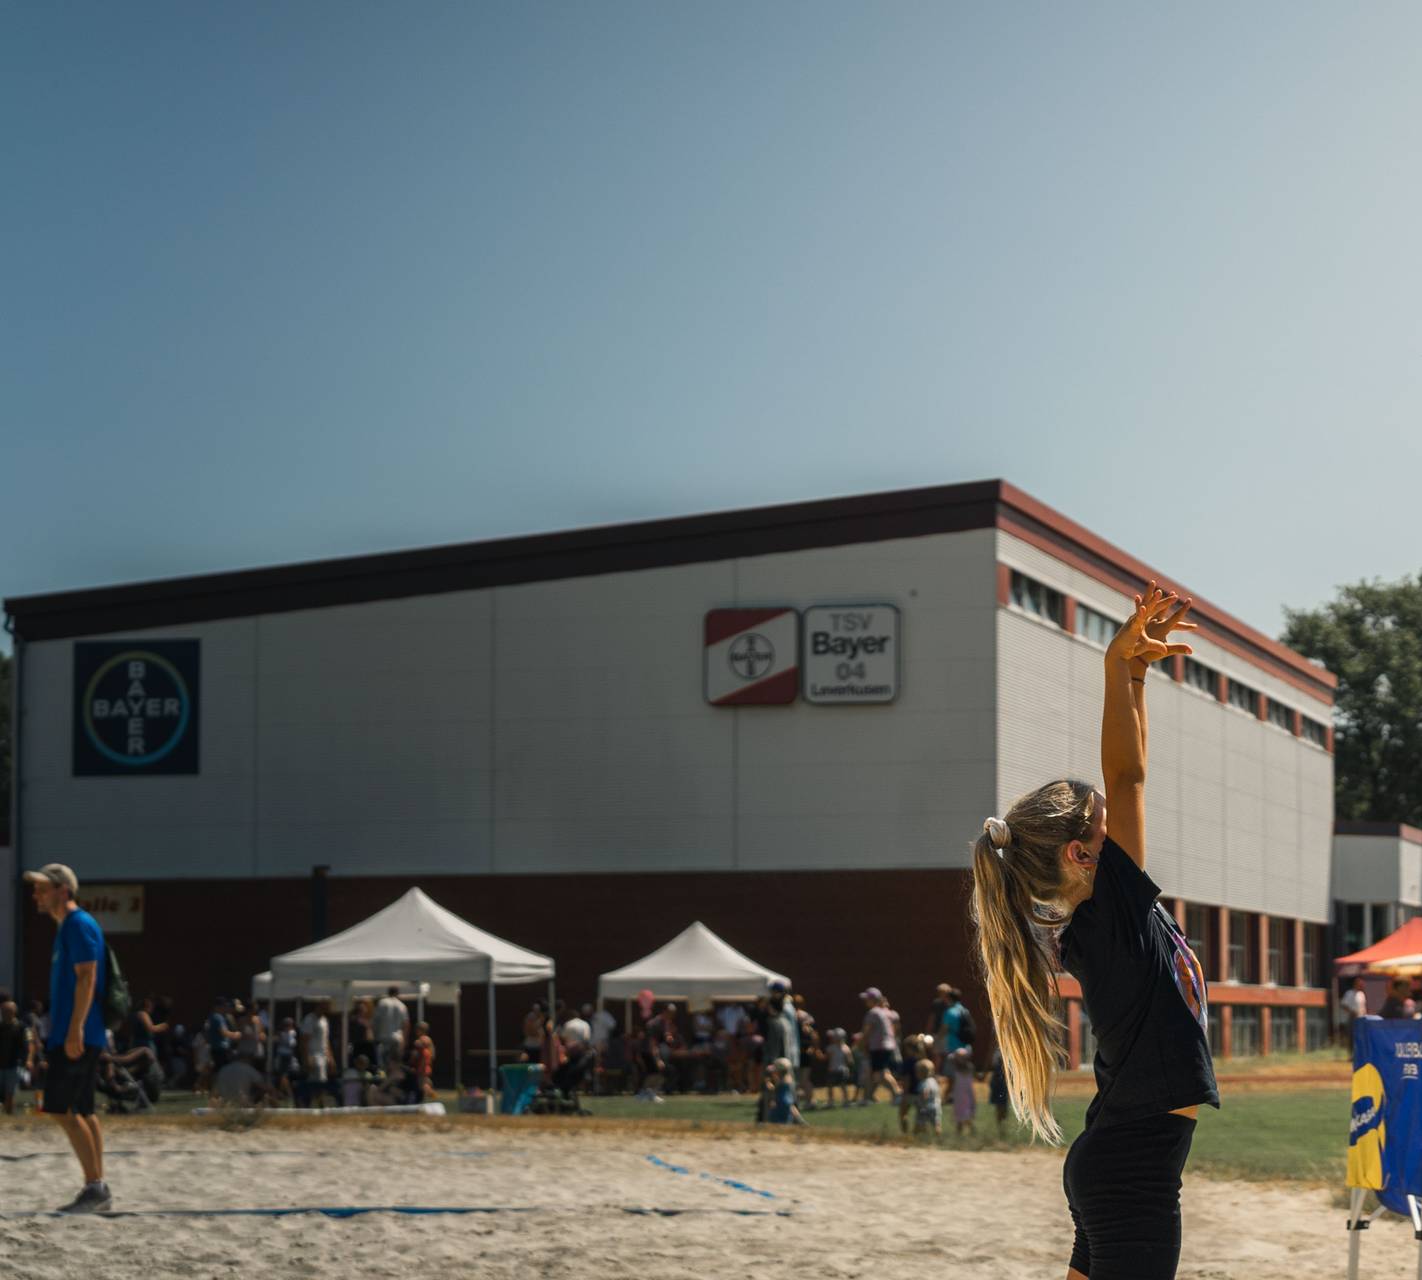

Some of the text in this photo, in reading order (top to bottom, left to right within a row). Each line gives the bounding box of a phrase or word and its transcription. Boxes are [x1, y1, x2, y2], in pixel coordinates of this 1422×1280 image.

[829, 613, 873, 631] TSV
[812, 631, 891, 659] Bayer
[836, 663, 865, 681] 04
[93, 698, 180, 717] BAYER
[128, 661, 145, 754] BAYER
